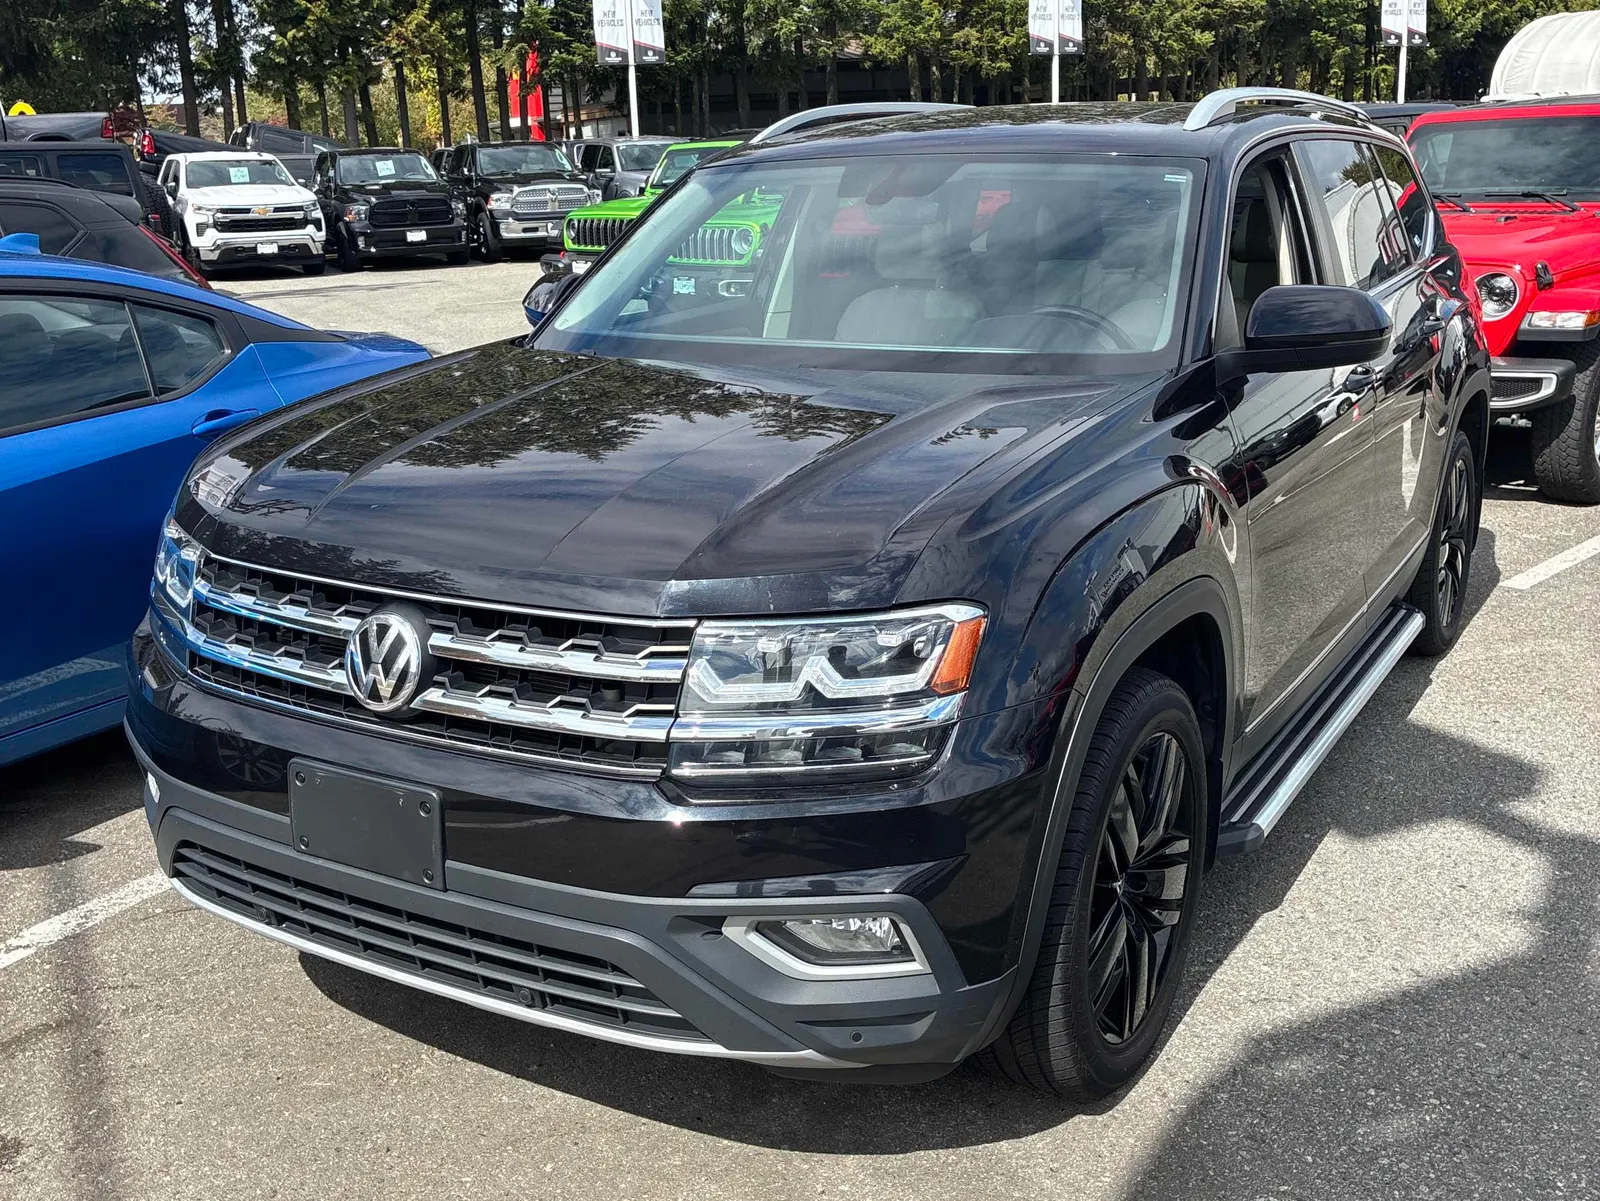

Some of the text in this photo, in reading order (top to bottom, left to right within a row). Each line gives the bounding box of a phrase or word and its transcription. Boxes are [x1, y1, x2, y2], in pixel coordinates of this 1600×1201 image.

[602, 10, 616, 18] NEW
[640, 9, 653, 17] NEW
[597, 18, 625, 27] VEHICLES
[634, 17, 661, 26] VEHICLES
